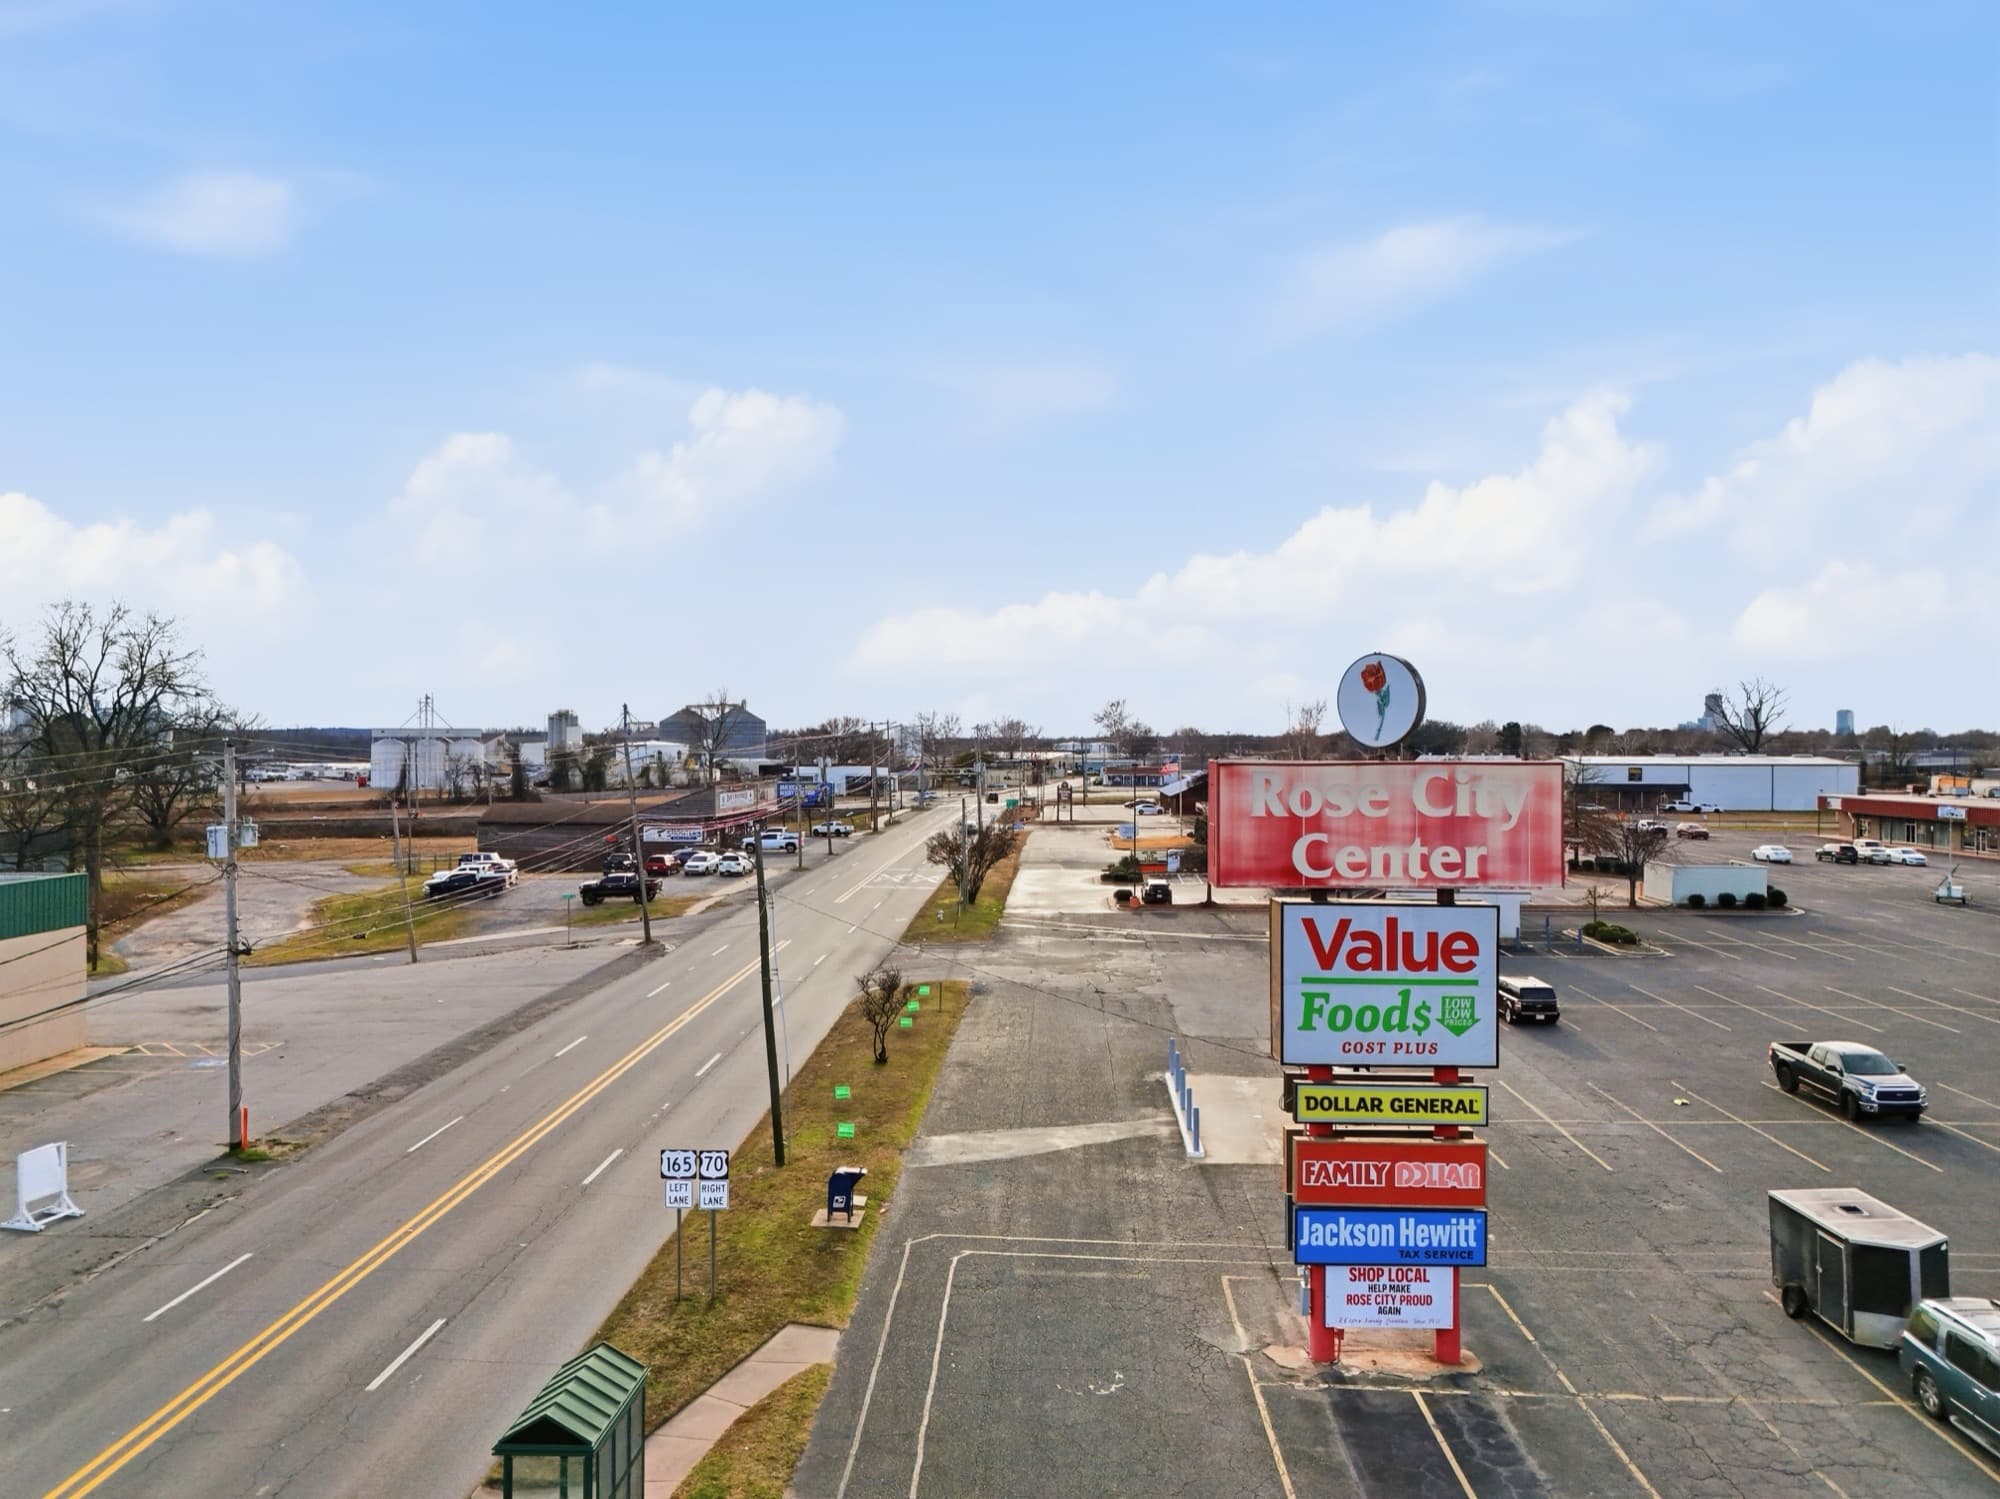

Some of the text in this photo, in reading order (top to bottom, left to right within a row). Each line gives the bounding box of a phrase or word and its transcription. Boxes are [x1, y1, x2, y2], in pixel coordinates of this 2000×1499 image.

[1250, 768, 1530, 832] Rose City
[1292, 833, 1488, 880] Center
[1301, 916, 1480, 973] Value
[1444, 998, 1472, 1009] LOW
[1444, 1008, 1472, 1019] LOW
[1341, 1041, 1438, 1054] COST PLUS
[1304, 1096, 1479, 1114] DOLLAR GENERAL
[667, 1157, 692, 1172] 165
[704, 1155, 724, 1172] 70
[1302, 1160, 1481, 1189] FAMILY DOLLAR
[669, 1183, 688, 1192] LEFT
[701, 1184, 725, 1193] RIGHT
[669, 1196, 689, 1205] LANE
[703, 1196, 724, 1205] LANE
[1300, 1216, 1477, 1248] Jackson Hewitt
[1399, 1250, 1474, 1260] TAX SERVICE
[1349, 1267, 1430, 1283] SHOP LOCAL
[1368, 1284, 1411, 1293] HELP MAKE
[1346, 1294, 1432, 1306] ROSE CITY PROUD
[1377, 1306, 1401, 1315] AGAIN
